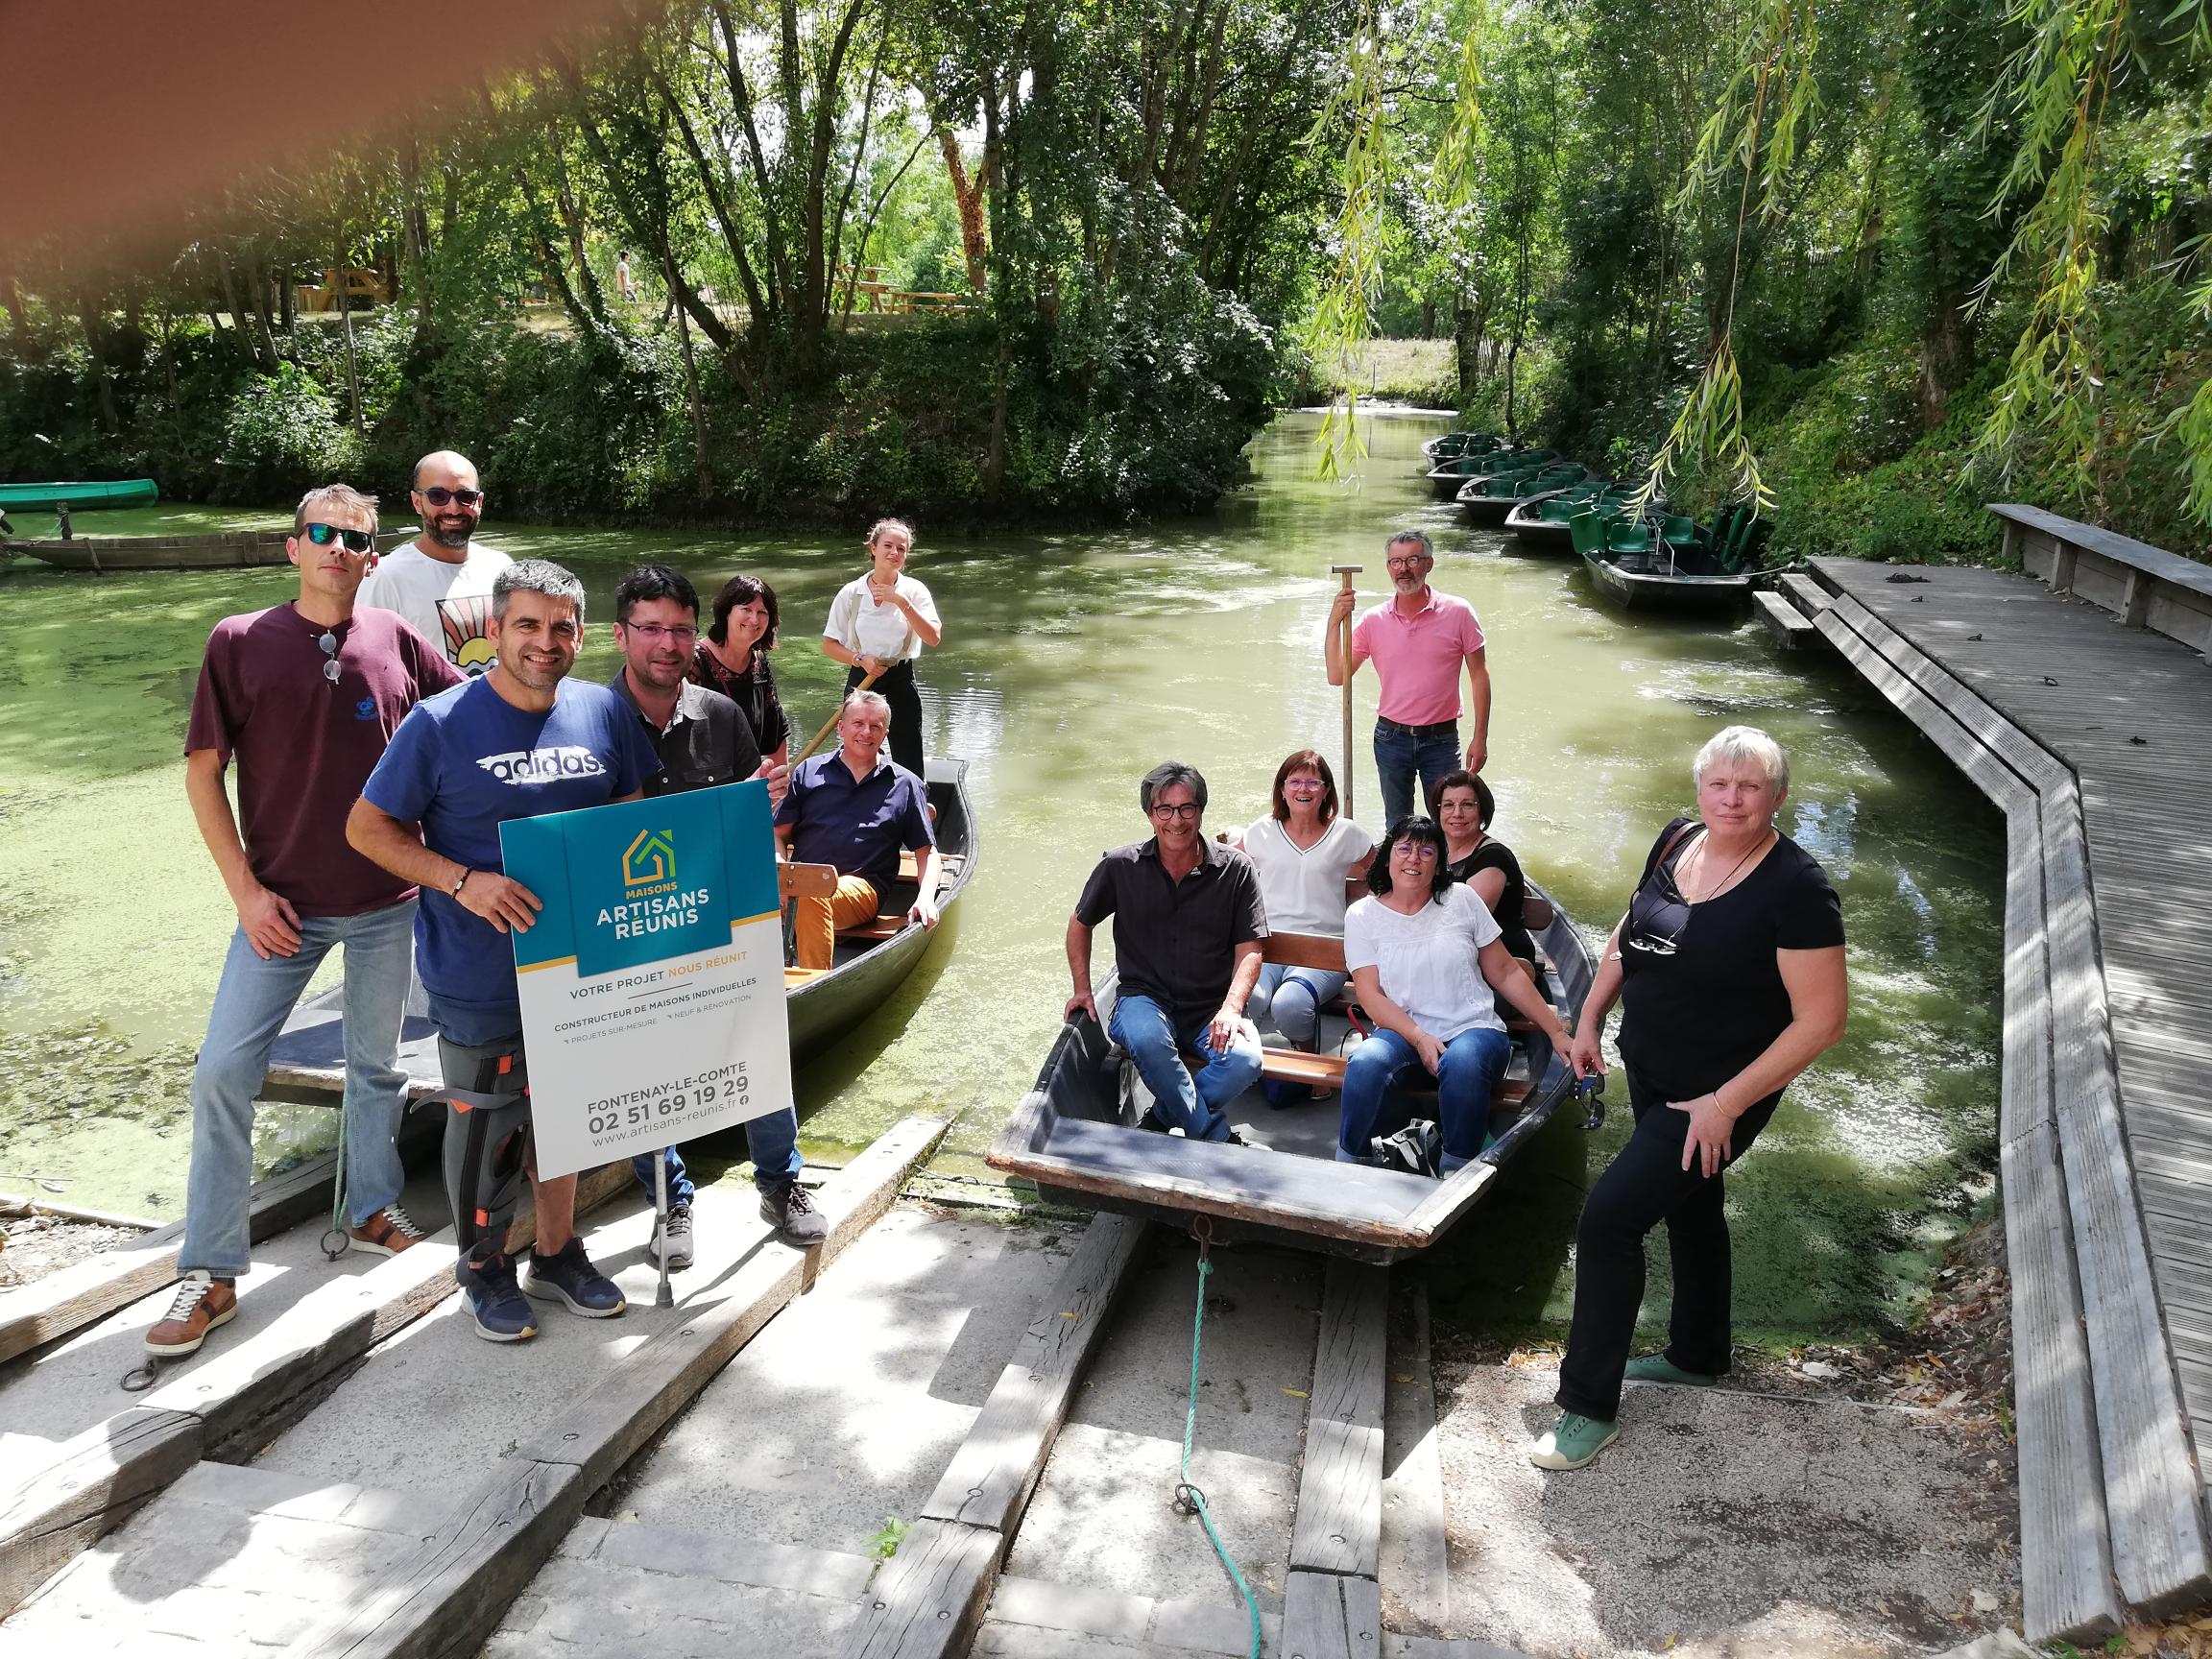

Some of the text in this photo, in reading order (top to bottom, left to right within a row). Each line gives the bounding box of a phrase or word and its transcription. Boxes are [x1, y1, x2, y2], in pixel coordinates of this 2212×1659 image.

[490, 749, 600, 781] adidas
[596, 888, 709, 926] ARTISANS
[625, 881, 678, 900] MAISONS
[615, 908, 699, 940] RÉUNIS
[569, 950, 748, 999] VOTRE PROJET NOUS RÉUNIT
[554, 977, 757, 1032] CONSTRUCTEUR DE MAISONS INDIVIDUELLES
[571, 1030, 607, 1045] PROJETS
[608, 1018, 659, 1036] SUR-MESURE
[674, 1008, 695, 1020] NEUF
[588, 1061, 747, 1114] FONTENAY-LE-COMTE
[589, 1075, 749, 1134] 02 51 69 19 29
[592, 1097, 736, 1147] www.artisans-reunis.fr
